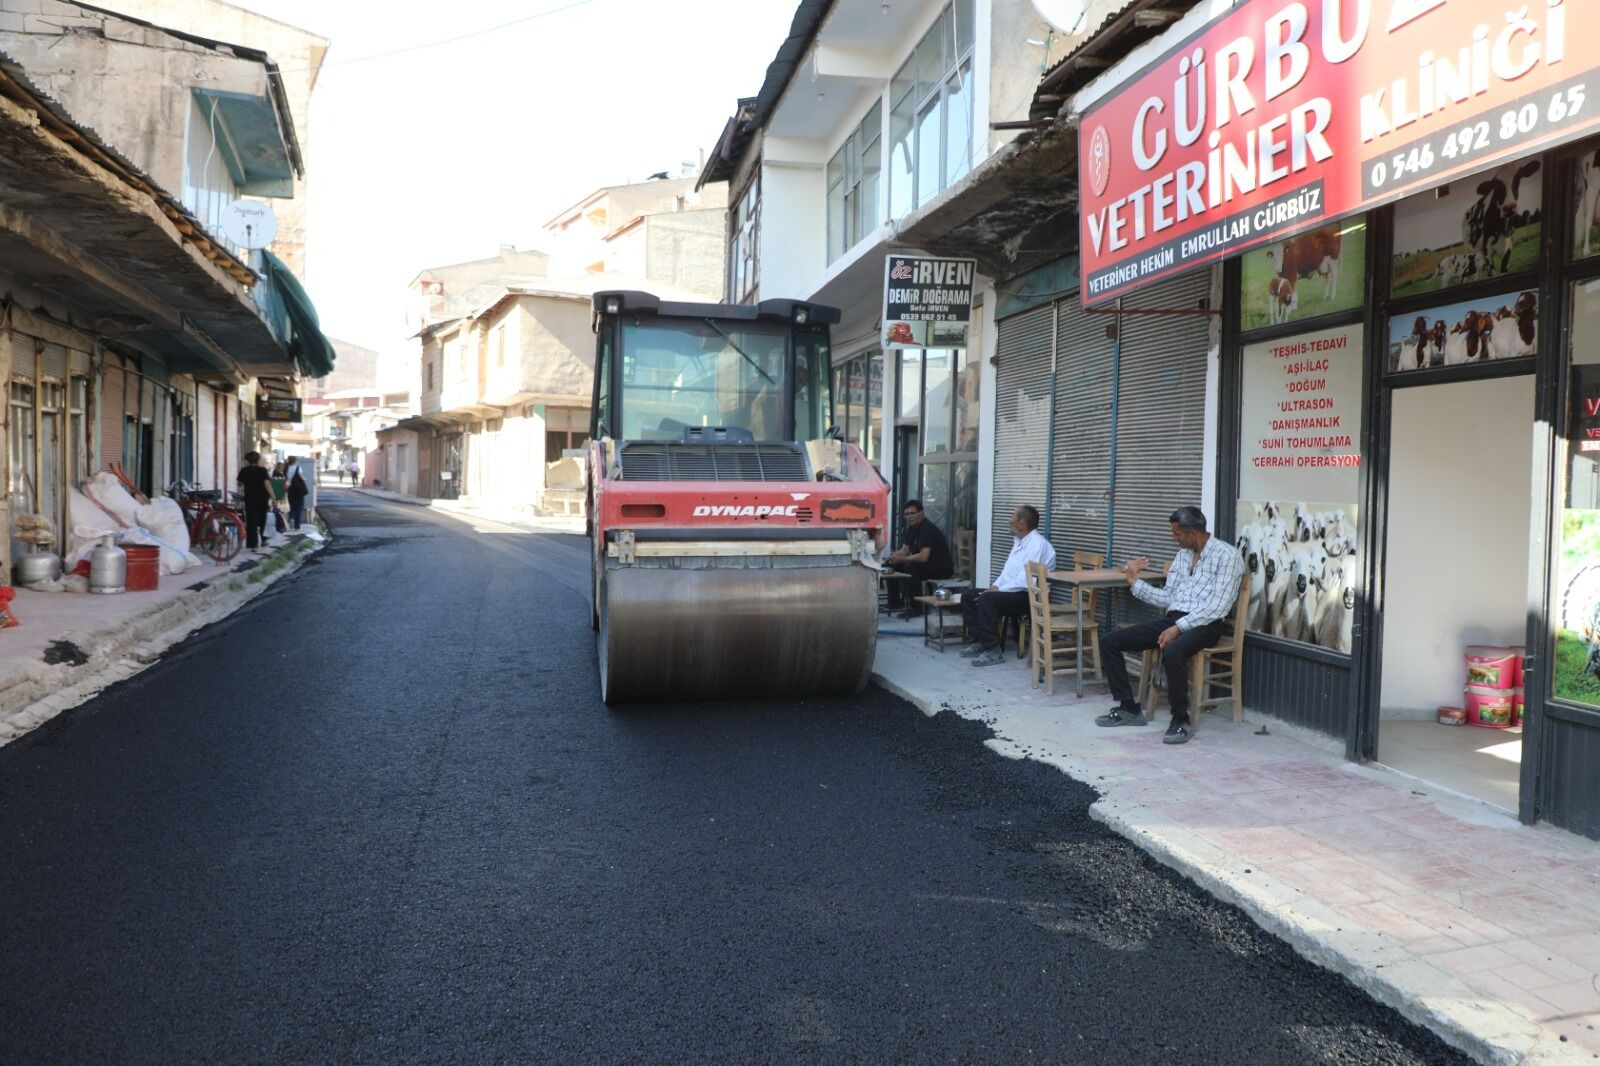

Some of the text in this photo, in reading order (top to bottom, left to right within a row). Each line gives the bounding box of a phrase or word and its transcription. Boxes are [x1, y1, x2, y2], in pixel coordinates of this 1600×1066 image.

[1087, 97, 1333, 258] VETERİNER
[1360, 0, 1566, 144] KLİNİĞİ
[1371, 84, 1586, 188] 0 546 492 80 65
[1088, 188, 1320, 294] VETERİNER HEKİM EMRULLAH GÜRBÜZ
[922, 286, 970, 305] DOĞRAMA
[901, 313, 919, 321] 0539
[1281, 398, 1334, 412] ULTRASON
[1287, 435, 1351, 448] TOHUMLAMA
[1297, 455, 1361, 467] OPERASYON
[693, 505, 798, 517] DYNAPAC
